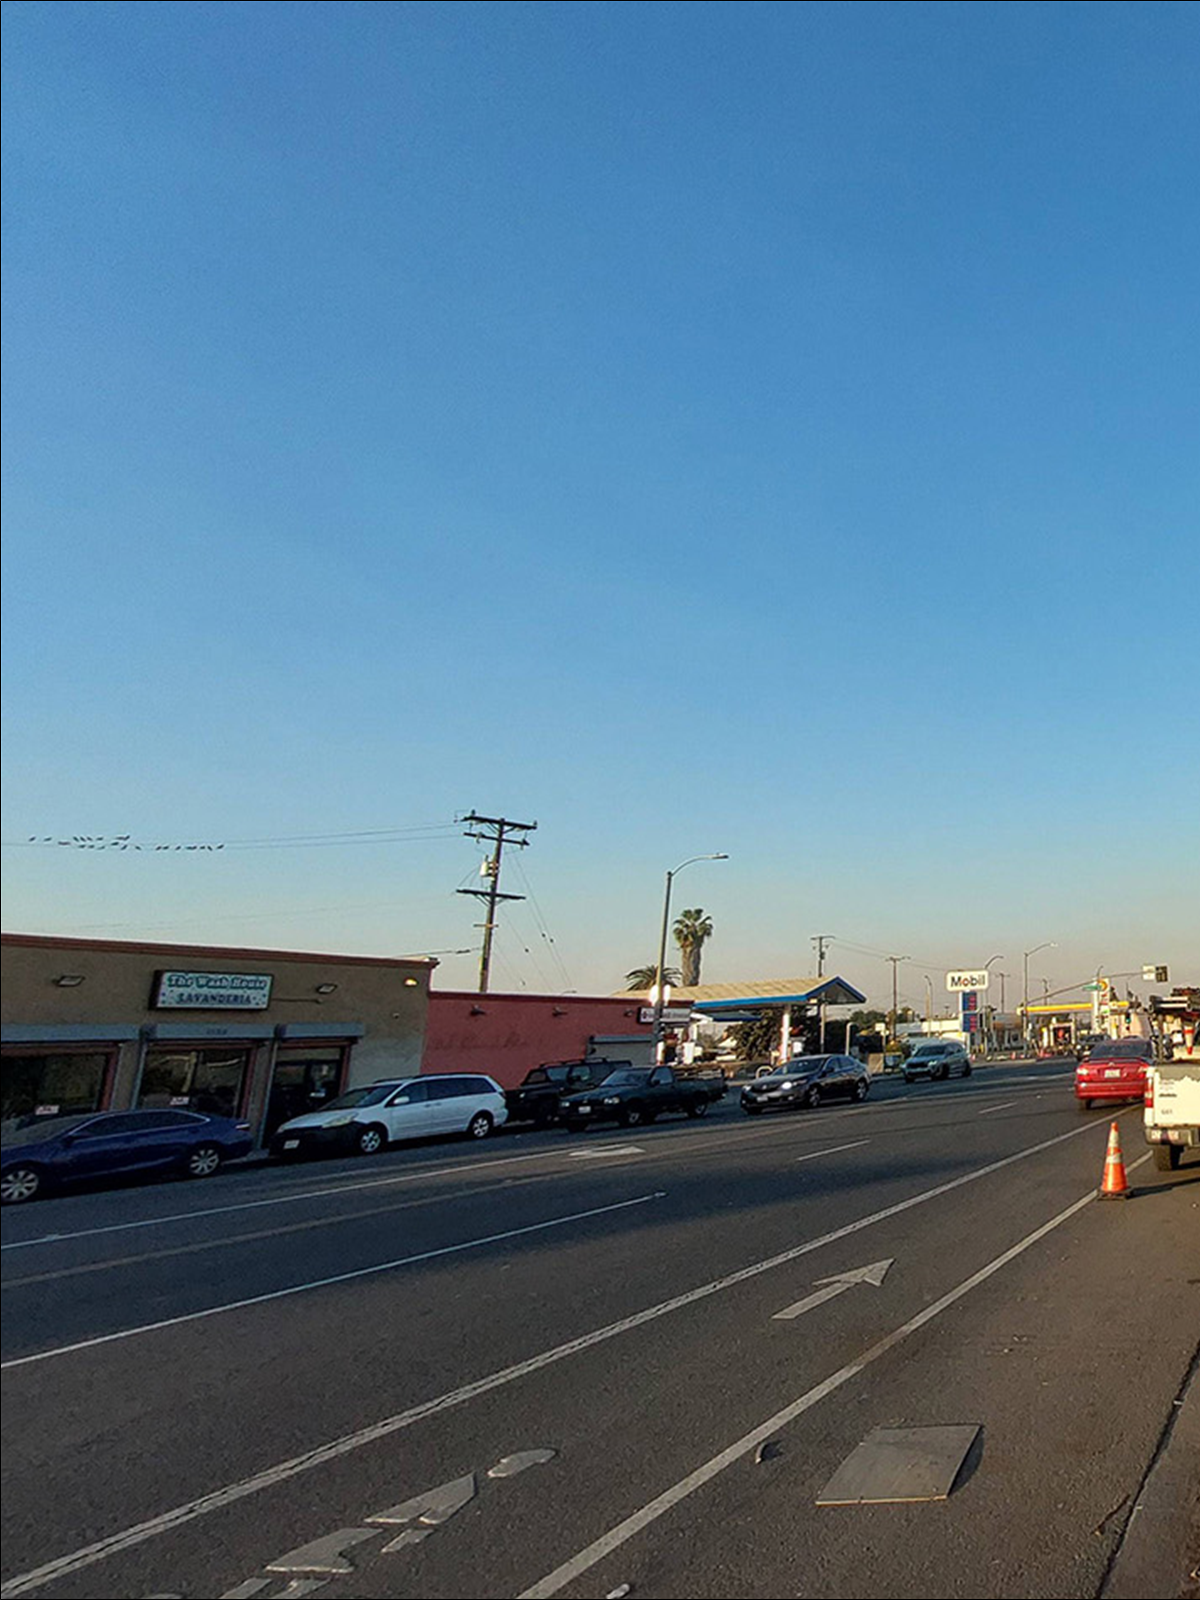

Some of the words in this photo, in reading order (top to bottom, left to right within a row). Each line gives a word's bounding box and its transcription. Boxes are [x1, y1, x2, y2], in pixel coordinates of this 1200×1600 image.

[167, 974, 194, 987] The
[195, 975, 229, 988] Wash
[229, 977, 267, 990] House
[951, 974, 986, 987] Mobil
[175, 993, 252, 1005] LAVANDERIA
